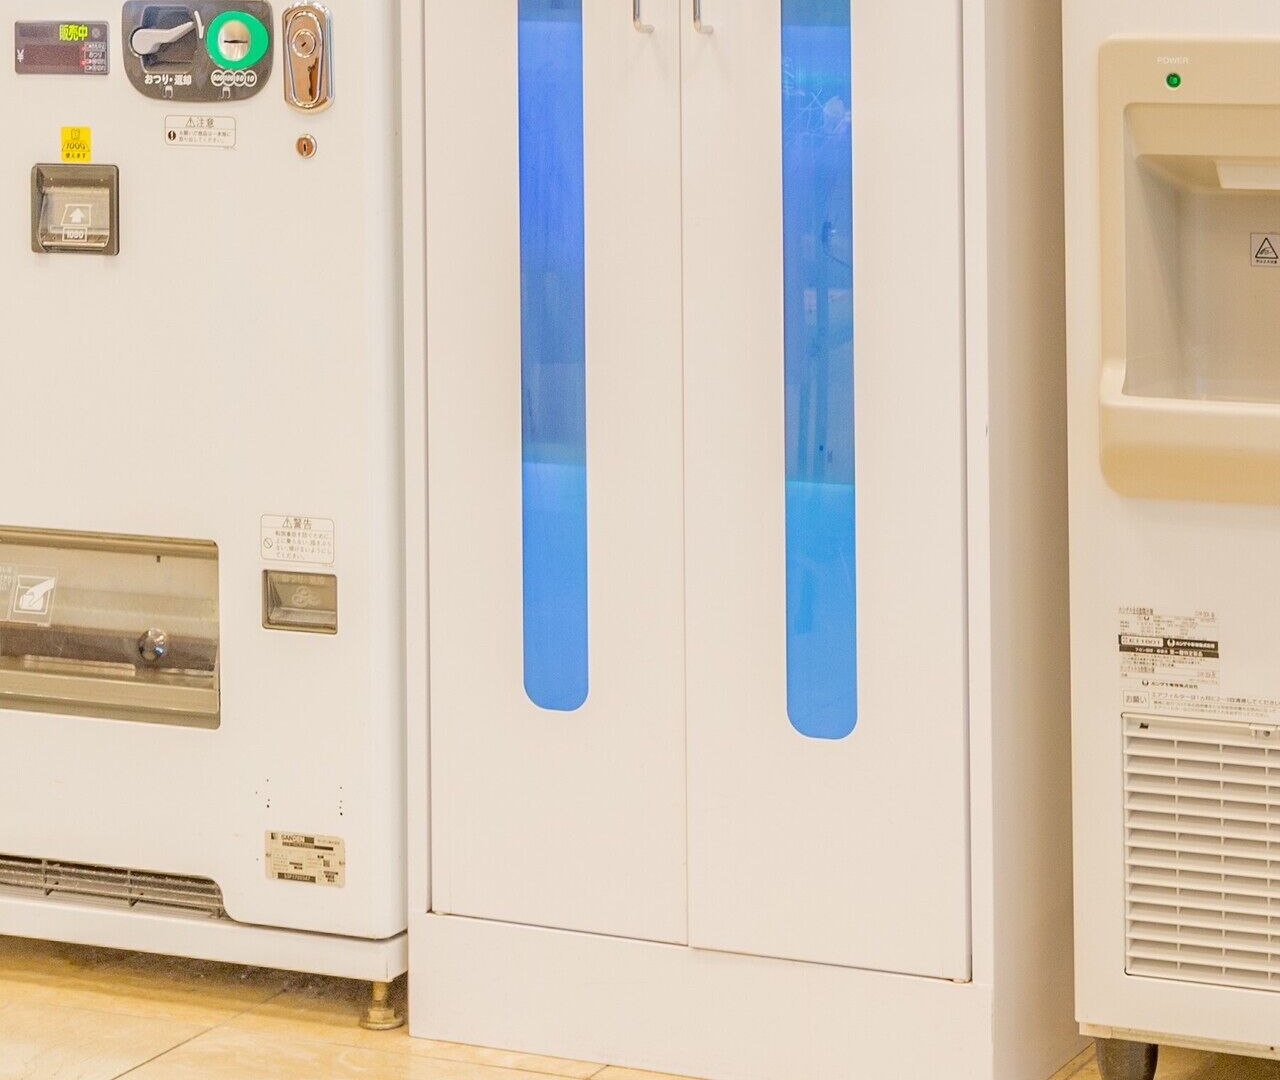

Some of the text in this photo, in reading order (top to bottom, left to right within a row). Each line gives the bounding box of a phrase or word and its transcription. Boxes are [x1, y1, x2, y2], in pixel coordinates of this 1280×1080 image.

[60, 24, 88, 41] 販売中
[1157, 56, 1189, 64] POWER
[144, 74, 192, 86] おつり・返却
